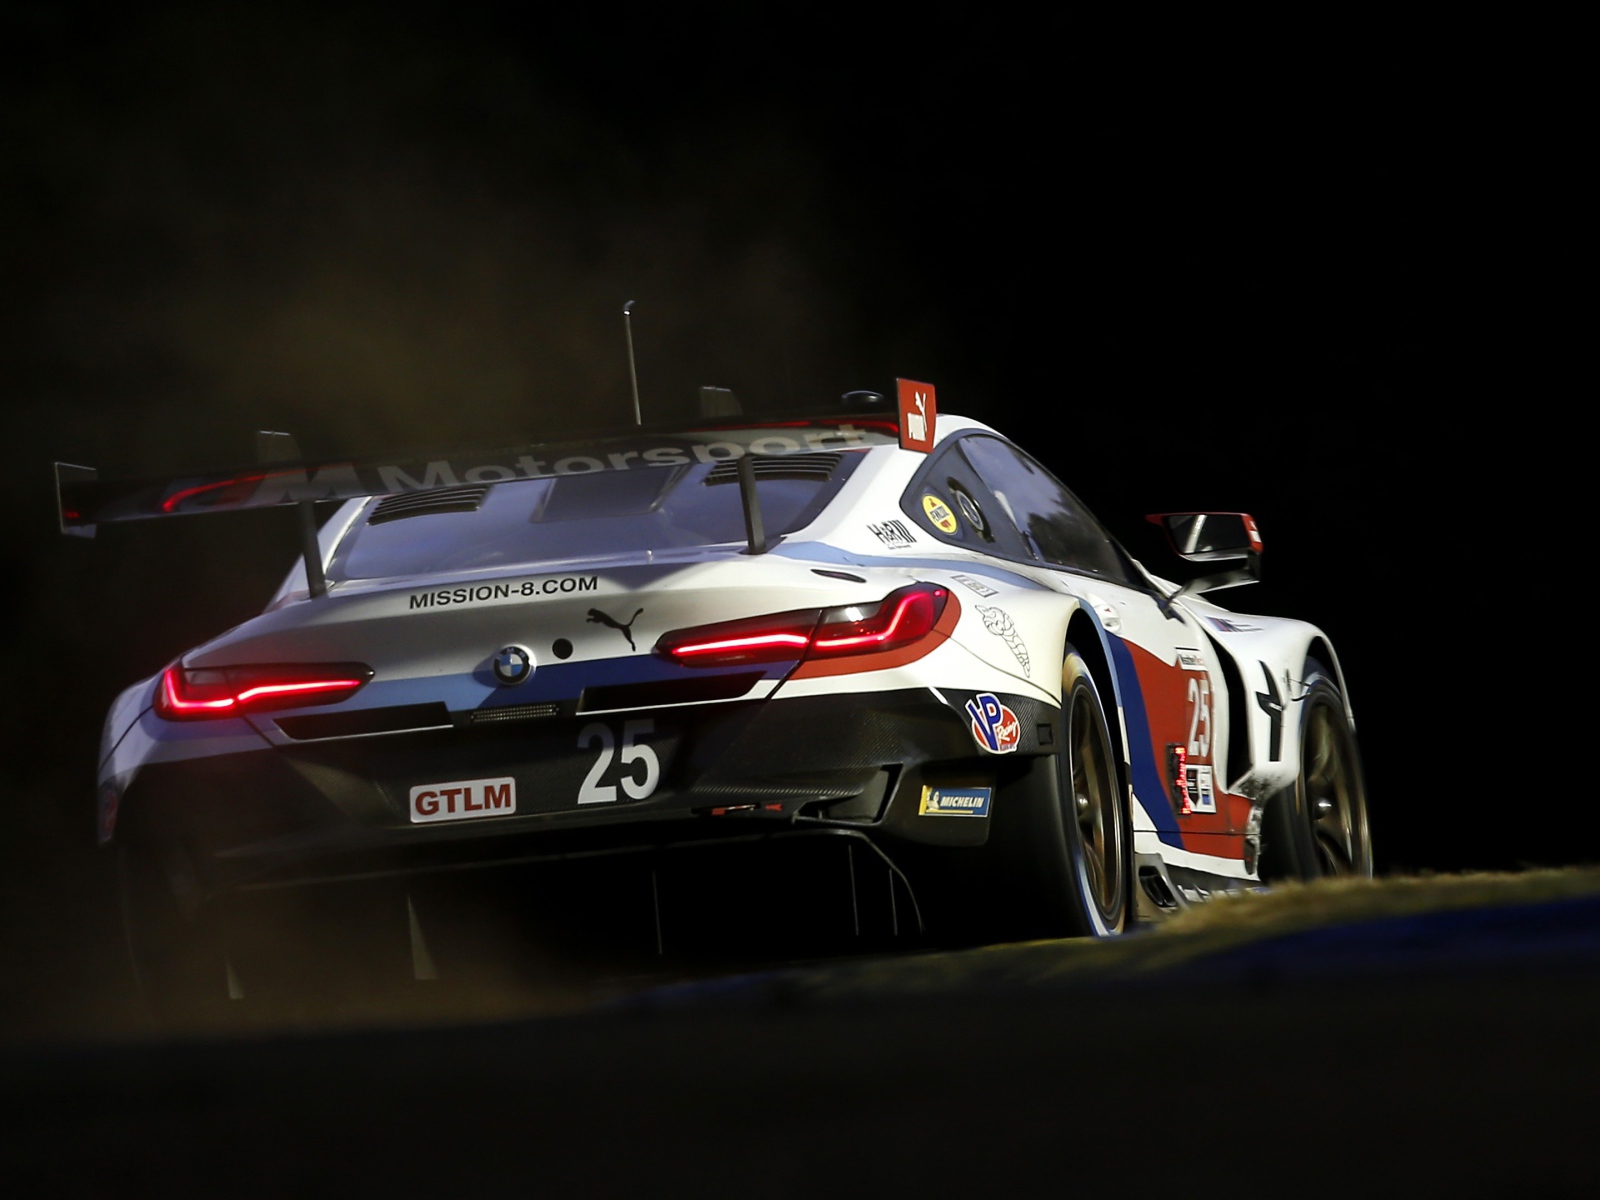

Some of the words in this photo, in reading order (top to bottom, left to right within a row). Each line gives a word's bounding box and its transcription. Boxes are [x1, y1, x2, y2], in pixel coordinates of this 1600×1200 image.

[377, 424, 866, 493] Motorsport
[409, 576, 599, 609] MISSION-8.COM
[965, 693, 1003, 752] VP
[1188, 678, 1211, 758] 25
[577, 718, 660, 804] 25
[415, 783, 512, 815] GTLM
[940, 796, 985, 808] MICHELIN
